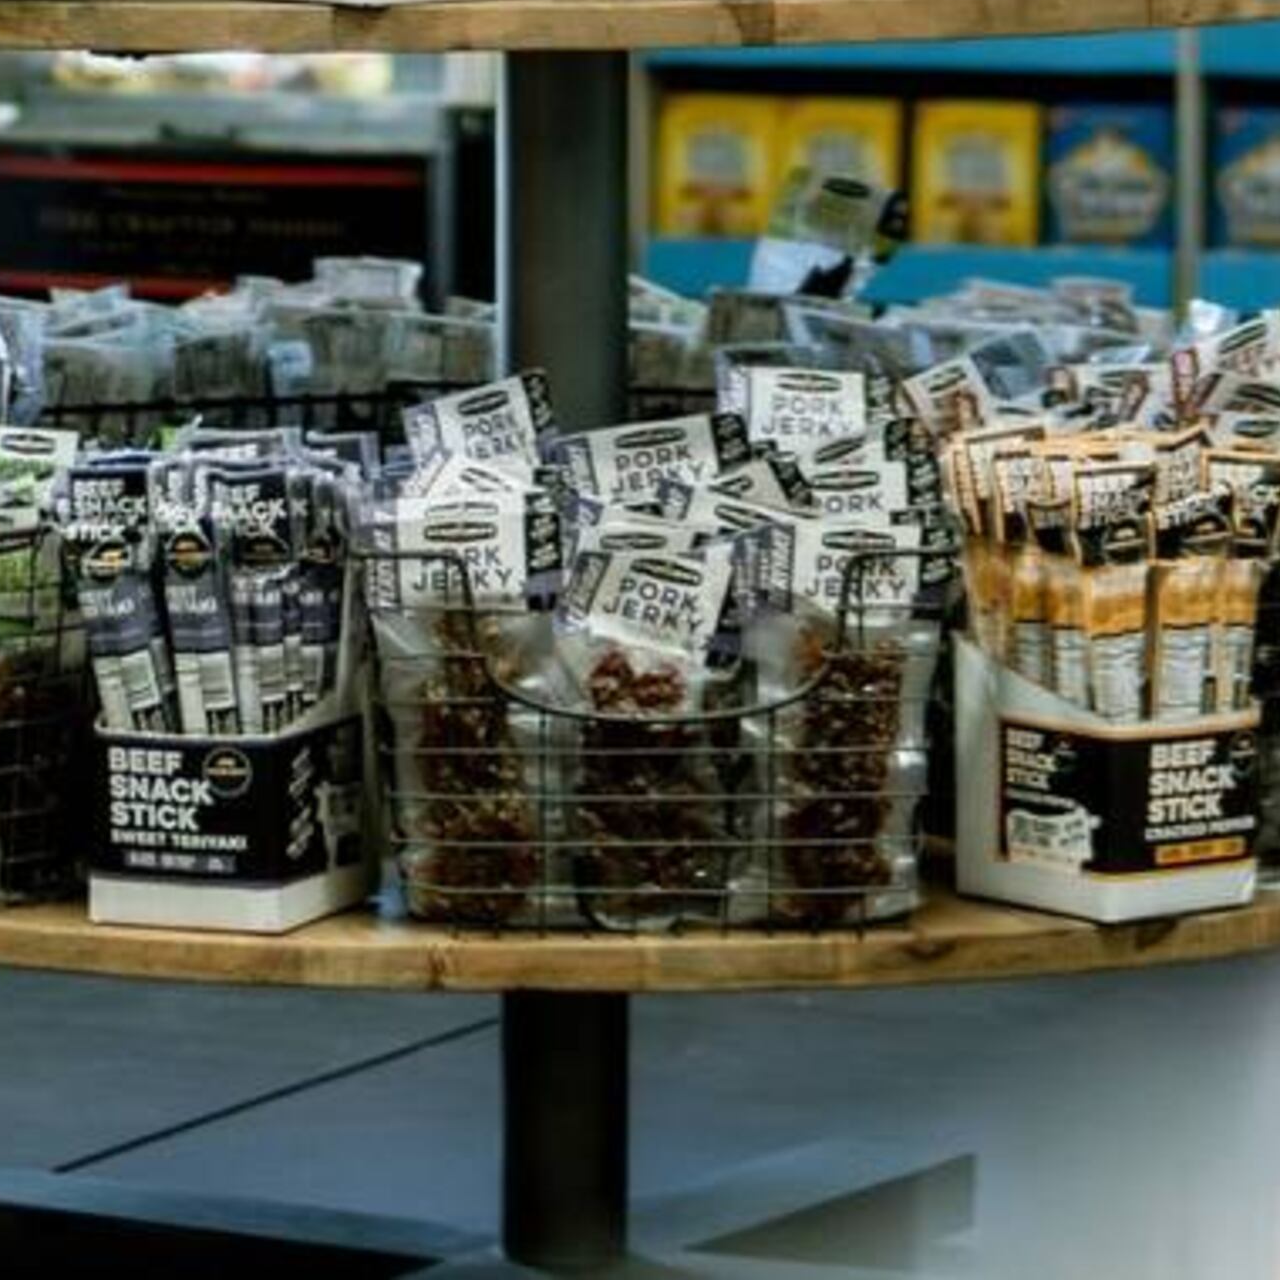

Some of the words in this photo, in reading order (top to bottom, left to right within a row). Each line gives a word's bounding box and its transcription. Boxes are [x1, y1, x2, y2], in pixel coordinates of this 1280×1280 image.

[771, 396, 840, 416] PORK
[462, 413, 520, 439] PORK
[761, 417, 852, 436] JERKY
[614, 444, 692, 471] PORK
[73, 479, 125, 496] BEEF
[73, 496, 146, 517] SNACK
[818, 492, 884, 514] ORK
[621, 576, 697, 612] PORK
[602, 596, 703, 635] JERKY
[107, 745, 183, 775] BEEF
[1150, 738, 1217, 769] BEEF
[109, 774, 215, 806] SNACK
[1149, 764, 1236, 796] SNACK
[109, 800, 199, 832] STICK
[1147, 793, 1222, 824] STICK
[110, 828, 166, 846] SWEET
[172, 833, 248, 850] TERIYAKI
